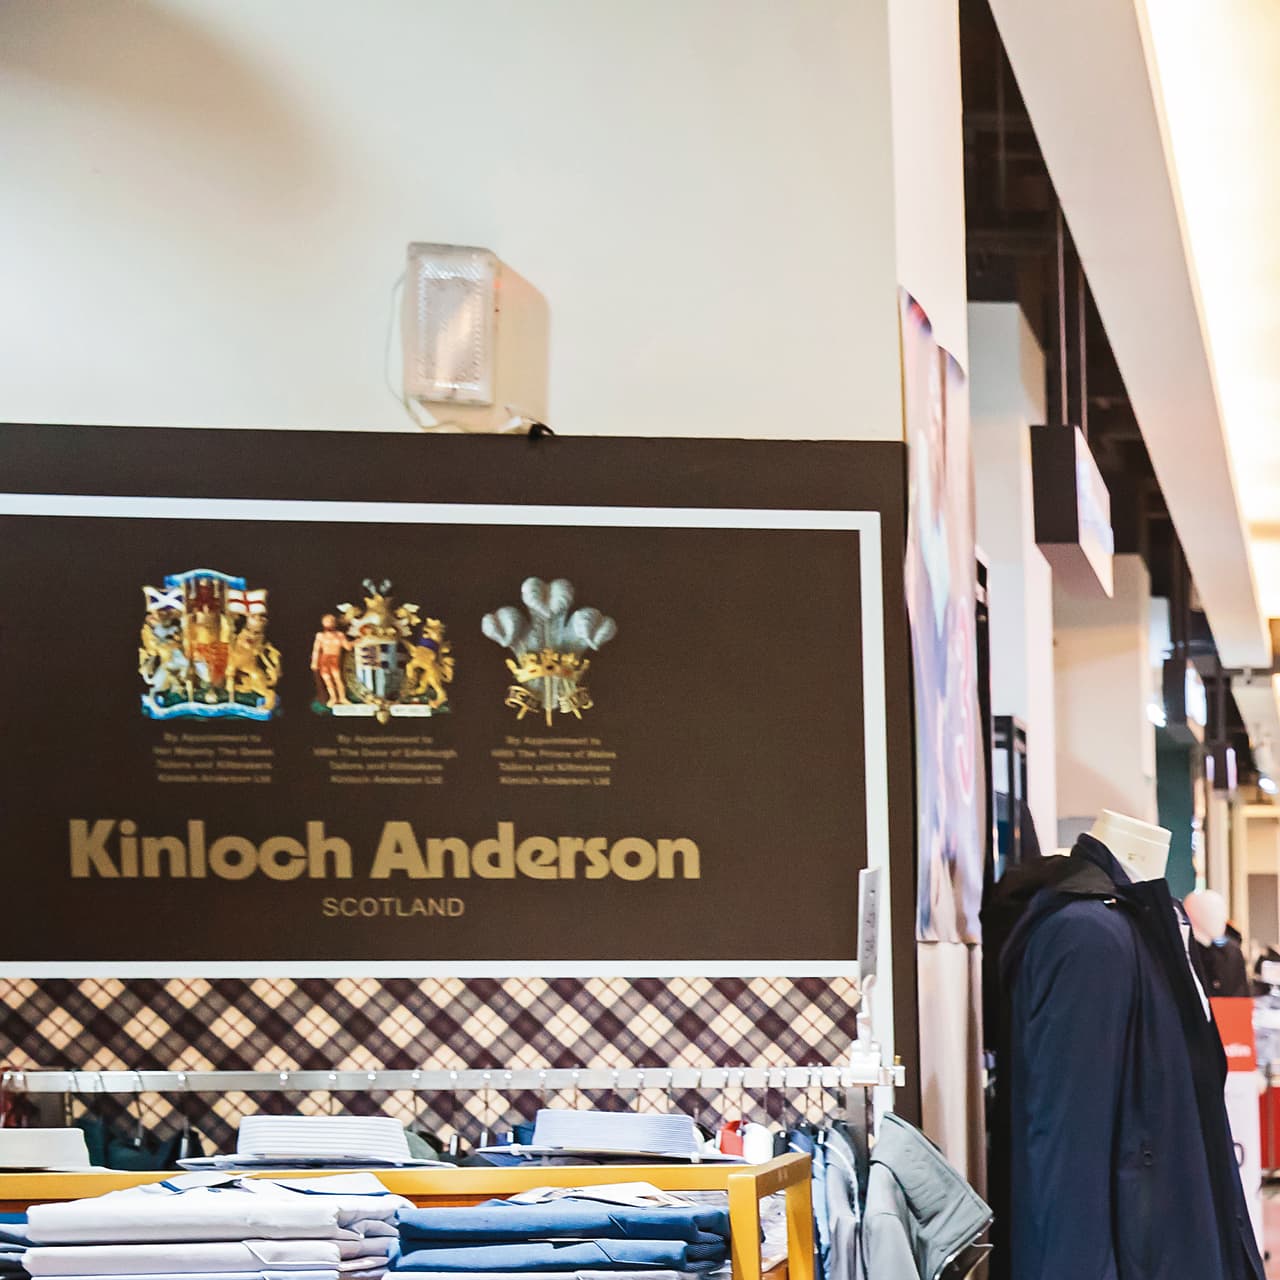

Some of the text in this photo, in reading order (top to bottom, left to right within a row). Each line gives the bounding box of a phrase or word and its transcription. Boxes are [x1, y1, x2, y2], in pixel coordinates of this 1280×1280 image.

[69, 818, 702, 881] Kinloch Anderson
[321, 896, 465, 918] SCOTLAND
